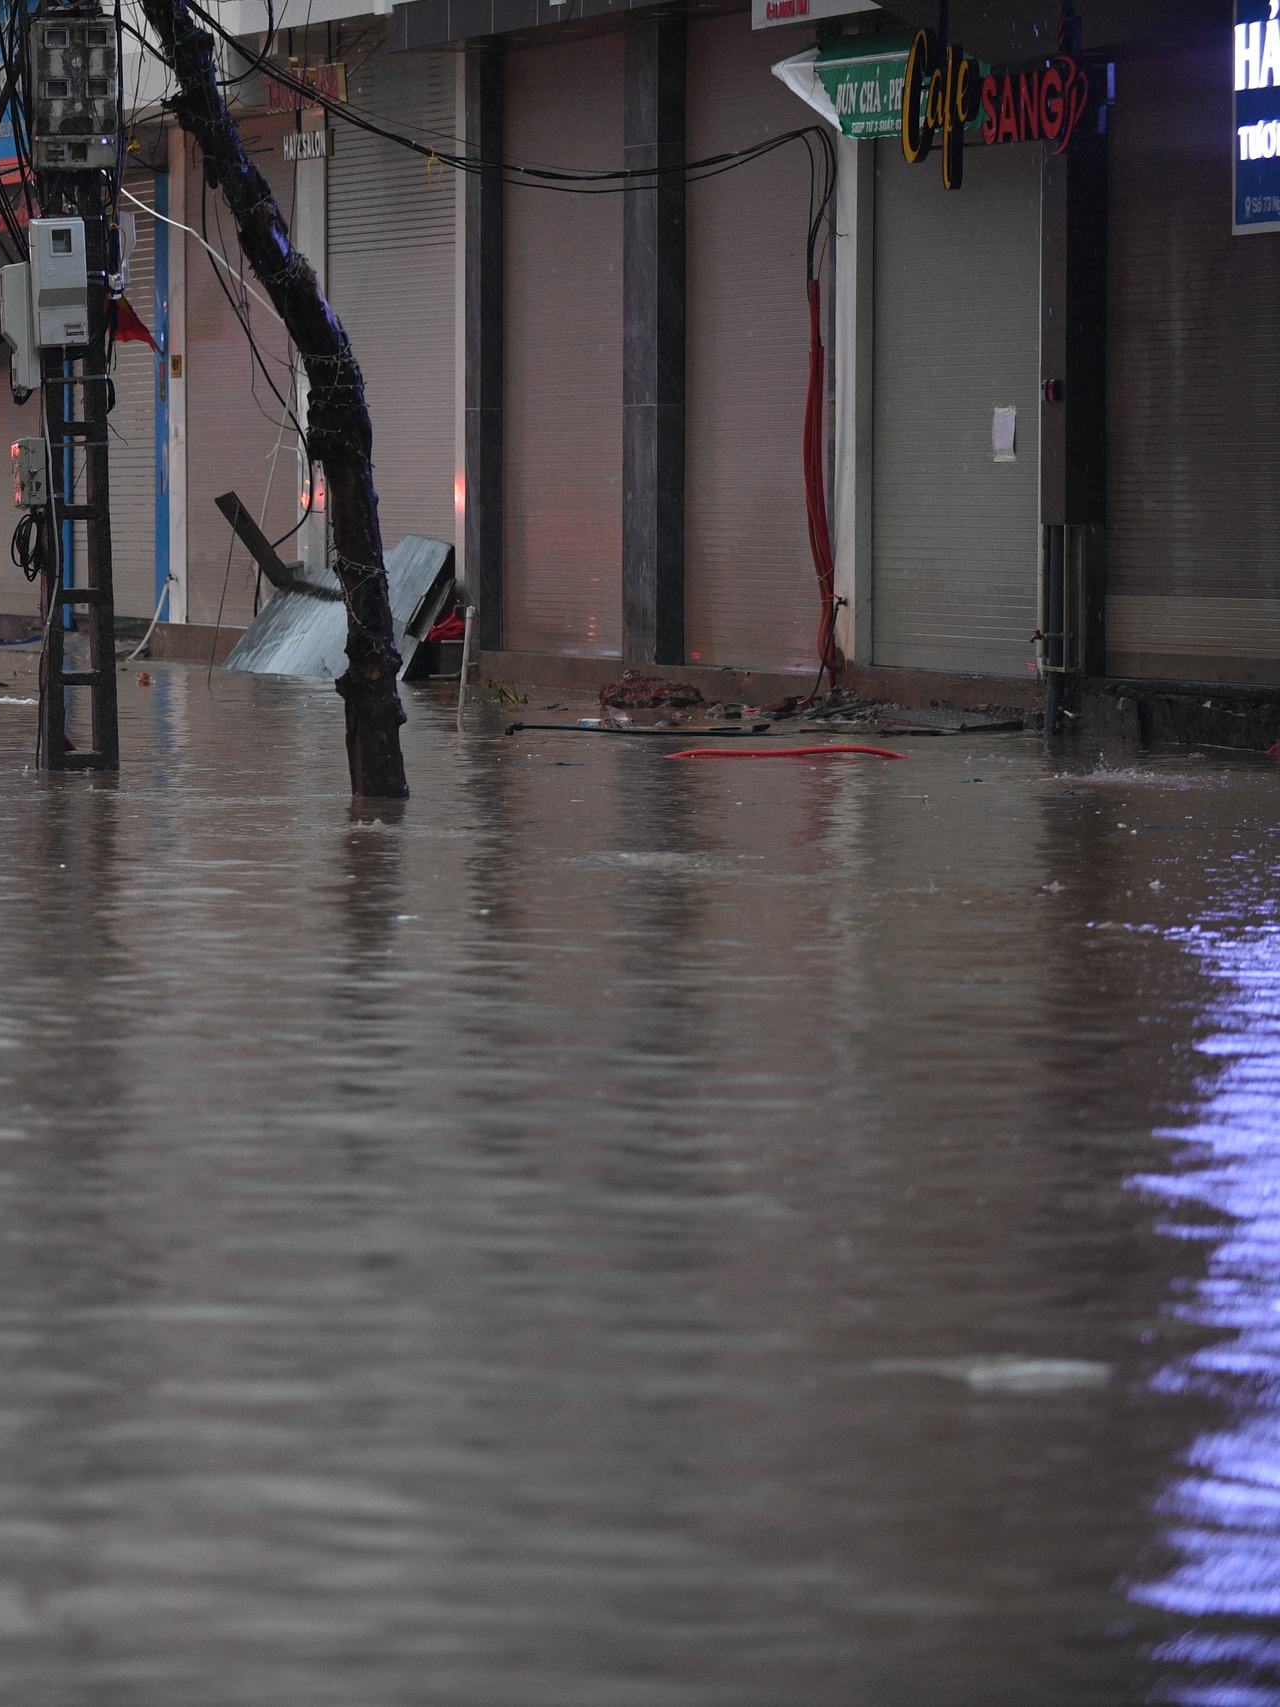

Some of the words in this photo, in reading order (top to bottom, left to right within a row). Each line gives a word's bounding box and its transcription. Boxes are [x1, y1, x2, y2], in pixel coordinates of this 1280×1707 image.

[835, 73, 858, 115] BÚN
[859, 66, 882, 114] CHẢ
[902, 28, 972, 190] Cafe
[982, 68, 1064, 145] SANG
[302, 130, 326, 158] SALON
[851, 121, 865, 134] SHIP
[873, 120, 878, 132] 3
